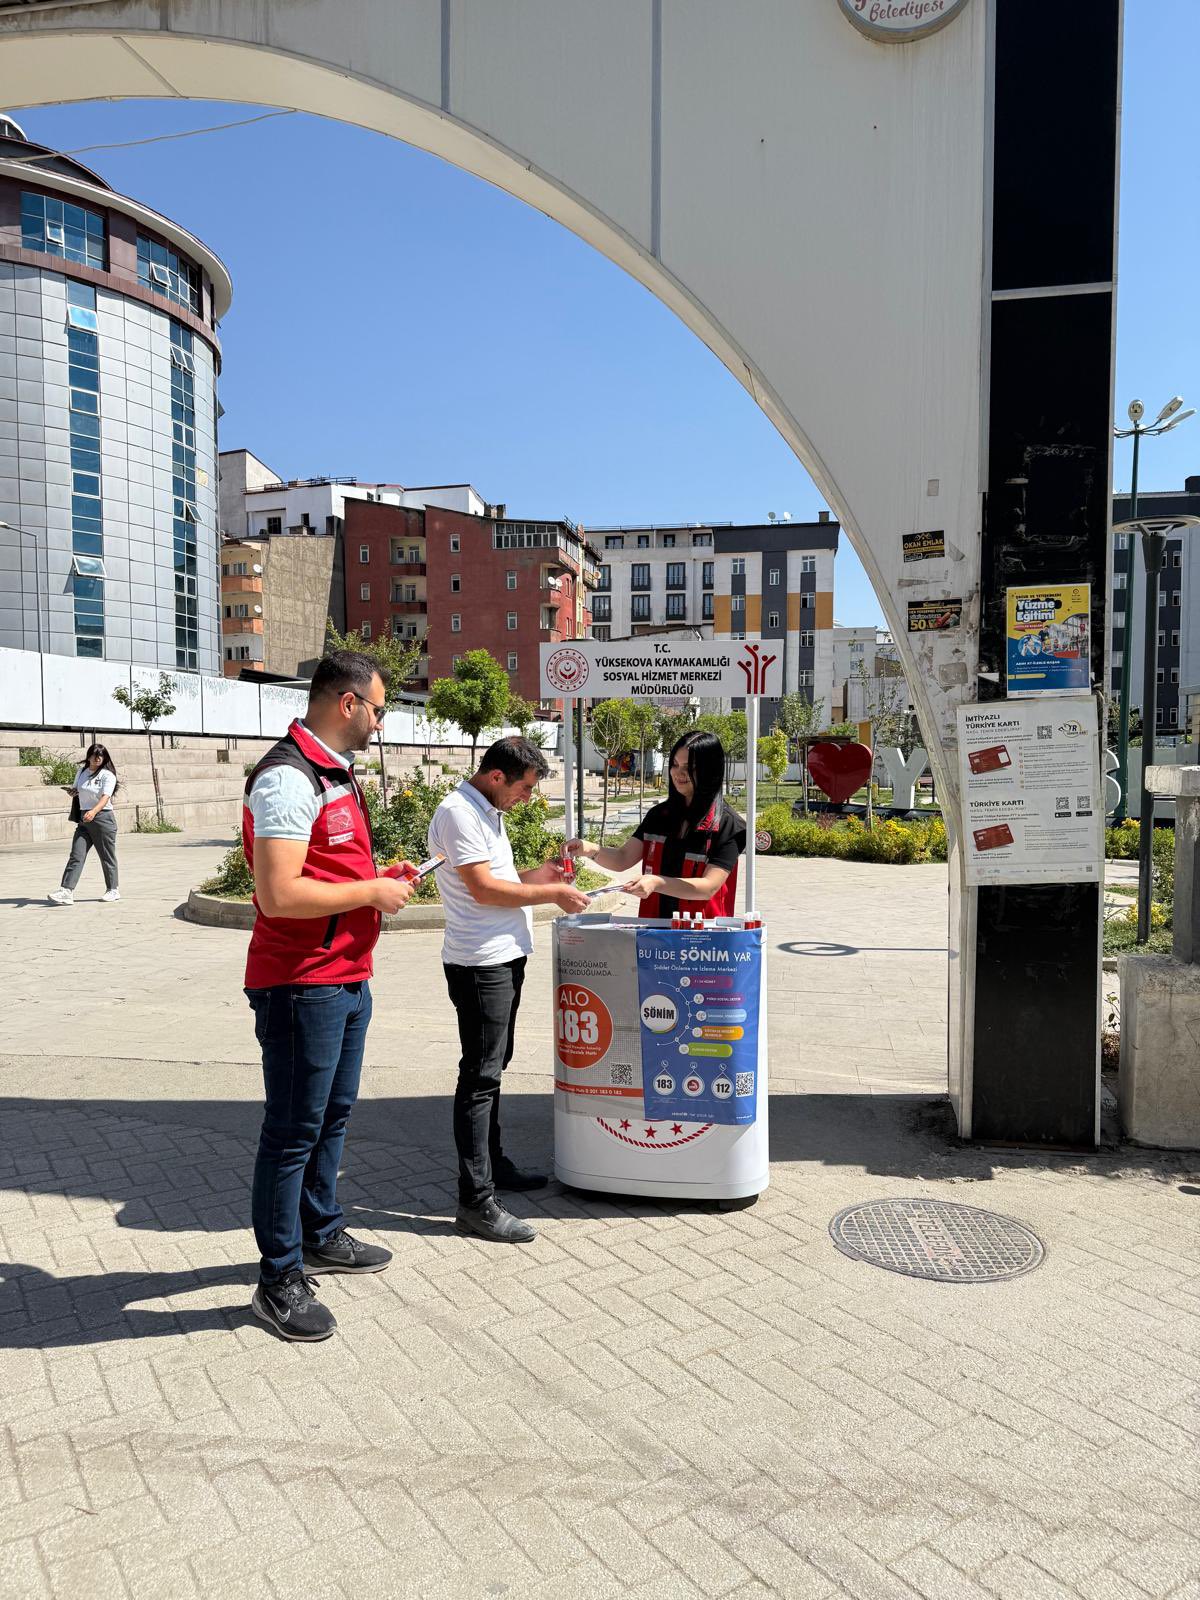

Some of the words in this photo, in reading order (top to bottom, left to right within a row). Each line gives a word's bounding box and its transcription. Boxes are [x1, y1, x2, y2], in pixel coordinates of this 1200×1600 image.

[869, 0, 944, 22] Belediyesi
[904, 541, 921, 549] OKAN
[922, 538, 944, 547] EMLAK
[1017, 599, 1055, 610] Yüzme
[1016, 609, 1055, 622] Eğitimi
[911, 619, 927, 630] 50
[653, 643, 671, 653] T.C.
[595, 656, 653, 668] YÜKSEKOVA
[655, 656, 730, 668] KAYMAKAMLIĞI
[603, 671, 639, 681] SOSYAL
[641, 669, 678, 681] HİZMET
[680, 669, 722, 681] MERKEZİ
[630, 683, 694, 695] MÜDÜRLÜĞÜ
[965, 714, 1001, 722] İMTİYAZLI
[965, 721, 996, 729] TÜRKİYE
[997, 720, 1020, 728] KARTI
[969, 799, 1000, 808] TÜRKİYE
[1001, 799, 1024, 807] KARTI
[638, 949, 652, 959] BU
[655, 947, 676, 960] İLDE
[680, 946, 729, 965] ŞÖNİM
[560, 991, 590, 1007] ALO
[643, 1006, 675, 1021] ŞÖNİM
[556, 1009, 599, 1045] 183
[656, 1079, 673, 1089] 183
[715, 1083, 731, 1094] 112
